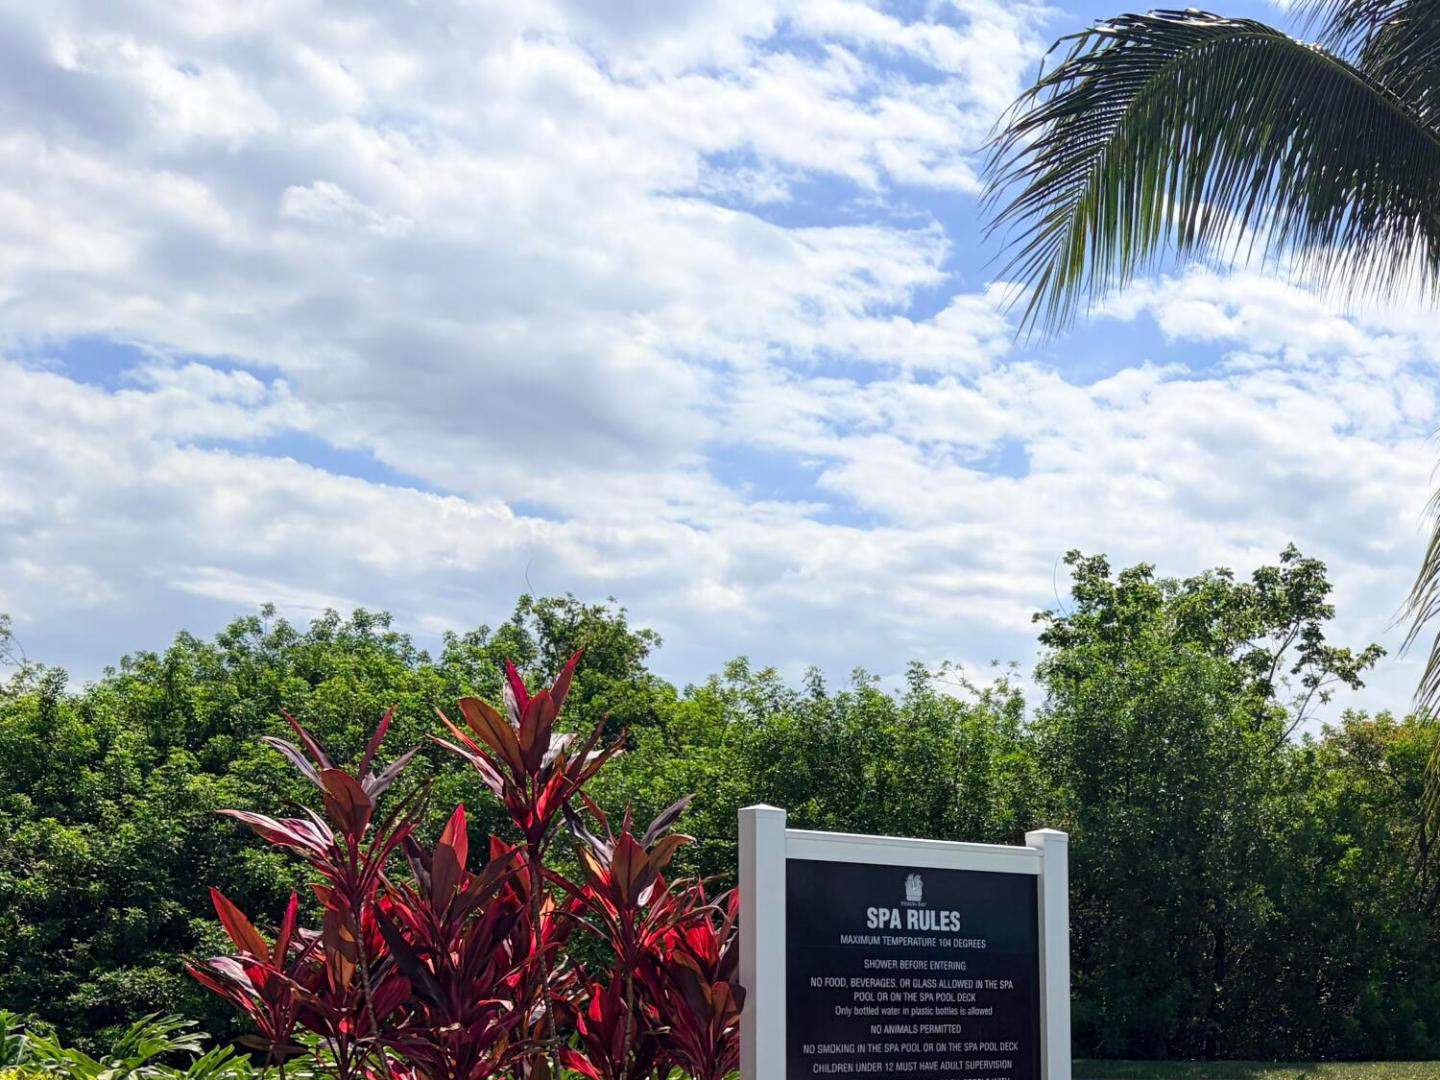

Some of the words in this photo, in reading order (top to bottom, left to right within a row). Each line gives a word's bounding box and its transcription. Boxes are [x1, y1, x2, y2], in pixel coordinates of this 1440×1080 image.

[867, 907, 901, 929] SPA
[907, 909, 960, 932] RULES
[841, 935, 880, 945] MAXIMUM
[883, 936, 936, 947] TEMPERATURE
[939, 939, 951, 947] 104
[953, 939, 986, 948] DEGREES
[864, 960, 897, 969] SHOWER
[900, 960, 928, 969] BEFORE
[930, 961, 966, 970] ENTERING
[811, 977, 822, 987] NO
[824, 978, 848, 988] FOOD,
[900, 979, 910, 988] OR
[913, 979, 936, 989] GLASS
[939, 980, 973, 989] ALLOWED
[976, 980, 982, 989] IN
[985, 980, 998, 989] THE
[1000, 980, 1013, 990] SPA
[854, 992, 874, 1001] POOL
[877, 992, 888, 1001] OR
[891, 992, 901, 1001] ON
[903, 992, 917, 1001] THE
[920, 993, 933, 1001] SPA
[936, 993, 955, 1001] POOL
[957, 993, 976, 1001] DECK
[835, 1006, 852, 1017] Only
[854, 1006, 879, 1015] bottled
[902, 1006, 909, 1015] in
[911, 1006, 933, 1017] plastic
[935, 1006, 958, 1015] bottles
[960, 1007, 966, 1015] is
[968, 1007, 992, 1015] allowed
[871, 1025, 881, 1034] NO
[884, 1025, 918, 1034] ANIMALS
[920, 1024, 961, 1033] PERMITTED
[803, 1045, 815, 1054] NO
[817, 1044, 855, 1054] SMOKING
[857, 1044, 865, 1053] IN
[868, 1044, 882, 1053] THE
[884, 1044, 899, 1053] SPA
[901, 1044, 920, 1052] POOL
[923, 1043, 933, 1052] OR
[936, 1043, 946, 1051] ON
[948, 1043, 962, 1051] THE
[964, 1043, 978, 1051] SPA
[980, 1042, 997, 1051] POOL
[1000, 1042, 1018, 1051] DECK
[813, 1064, 853, 1073] CHILDREN
[855, 1063, 882, 1072] UNDER
[886, 1063, 894, 1071] 12
[896, 1062, 917, 1071] MUST
[920, 1062, 938, 1070] HAVE
[940, 1061, 963, 1070] ADULT
[965, 1060, 1012, 1070] SUPERVISION
